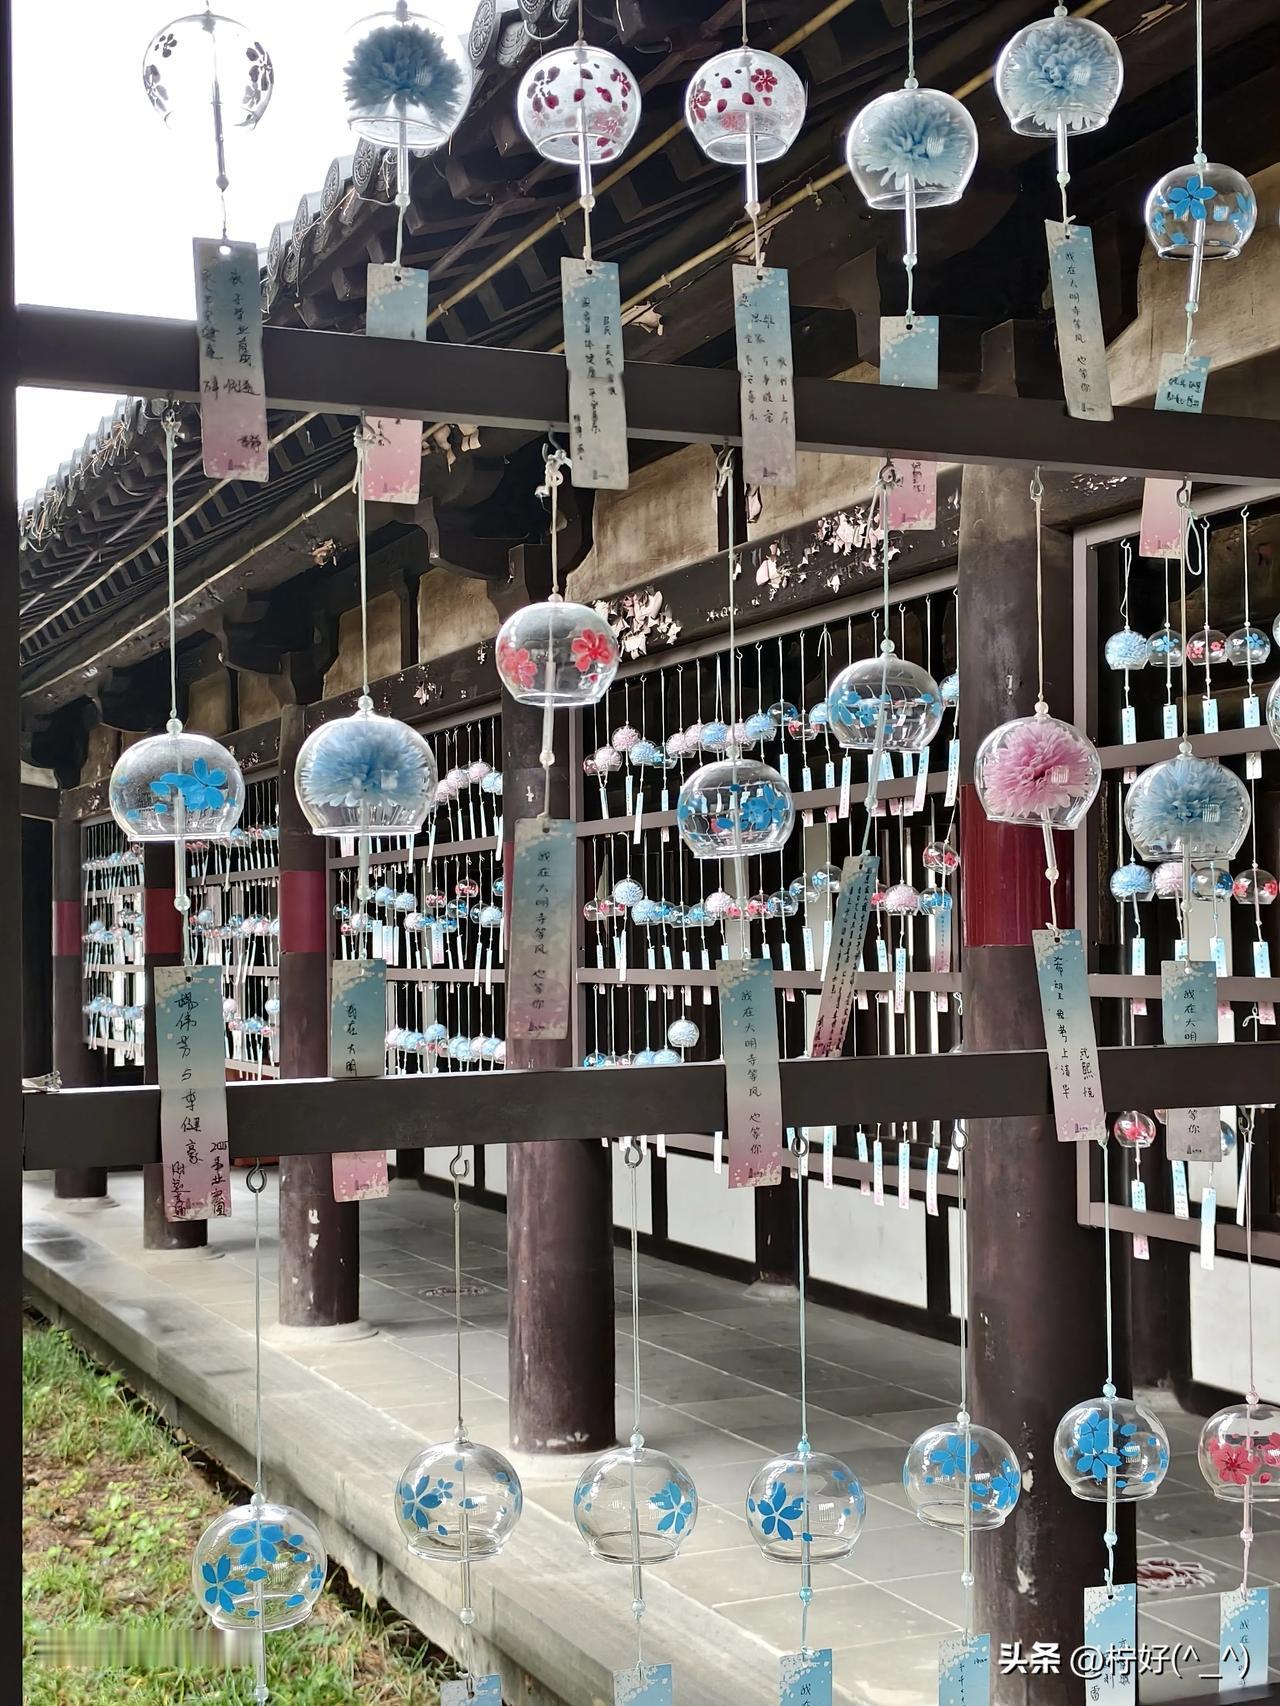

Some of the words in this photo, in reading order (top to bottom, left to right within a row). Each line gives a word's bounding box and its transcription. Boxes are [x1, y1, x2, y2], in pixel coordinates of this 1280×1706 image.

[1066, 253, 1085, 343] 我在大明寺等风
[1077, 356, 1091, 392] 也等你
[534, 851, 551, 955] 我在大明寺等风
[532, 968, 546, 1010] 也等你
[1183, 989, 1198, 1042] 我在大明
[346, 1004, 358, 1077] 我在大明
[741, 990, 762, 1097] 我在大明寺等风
[749, 1112, 762, 1154] 也等你
